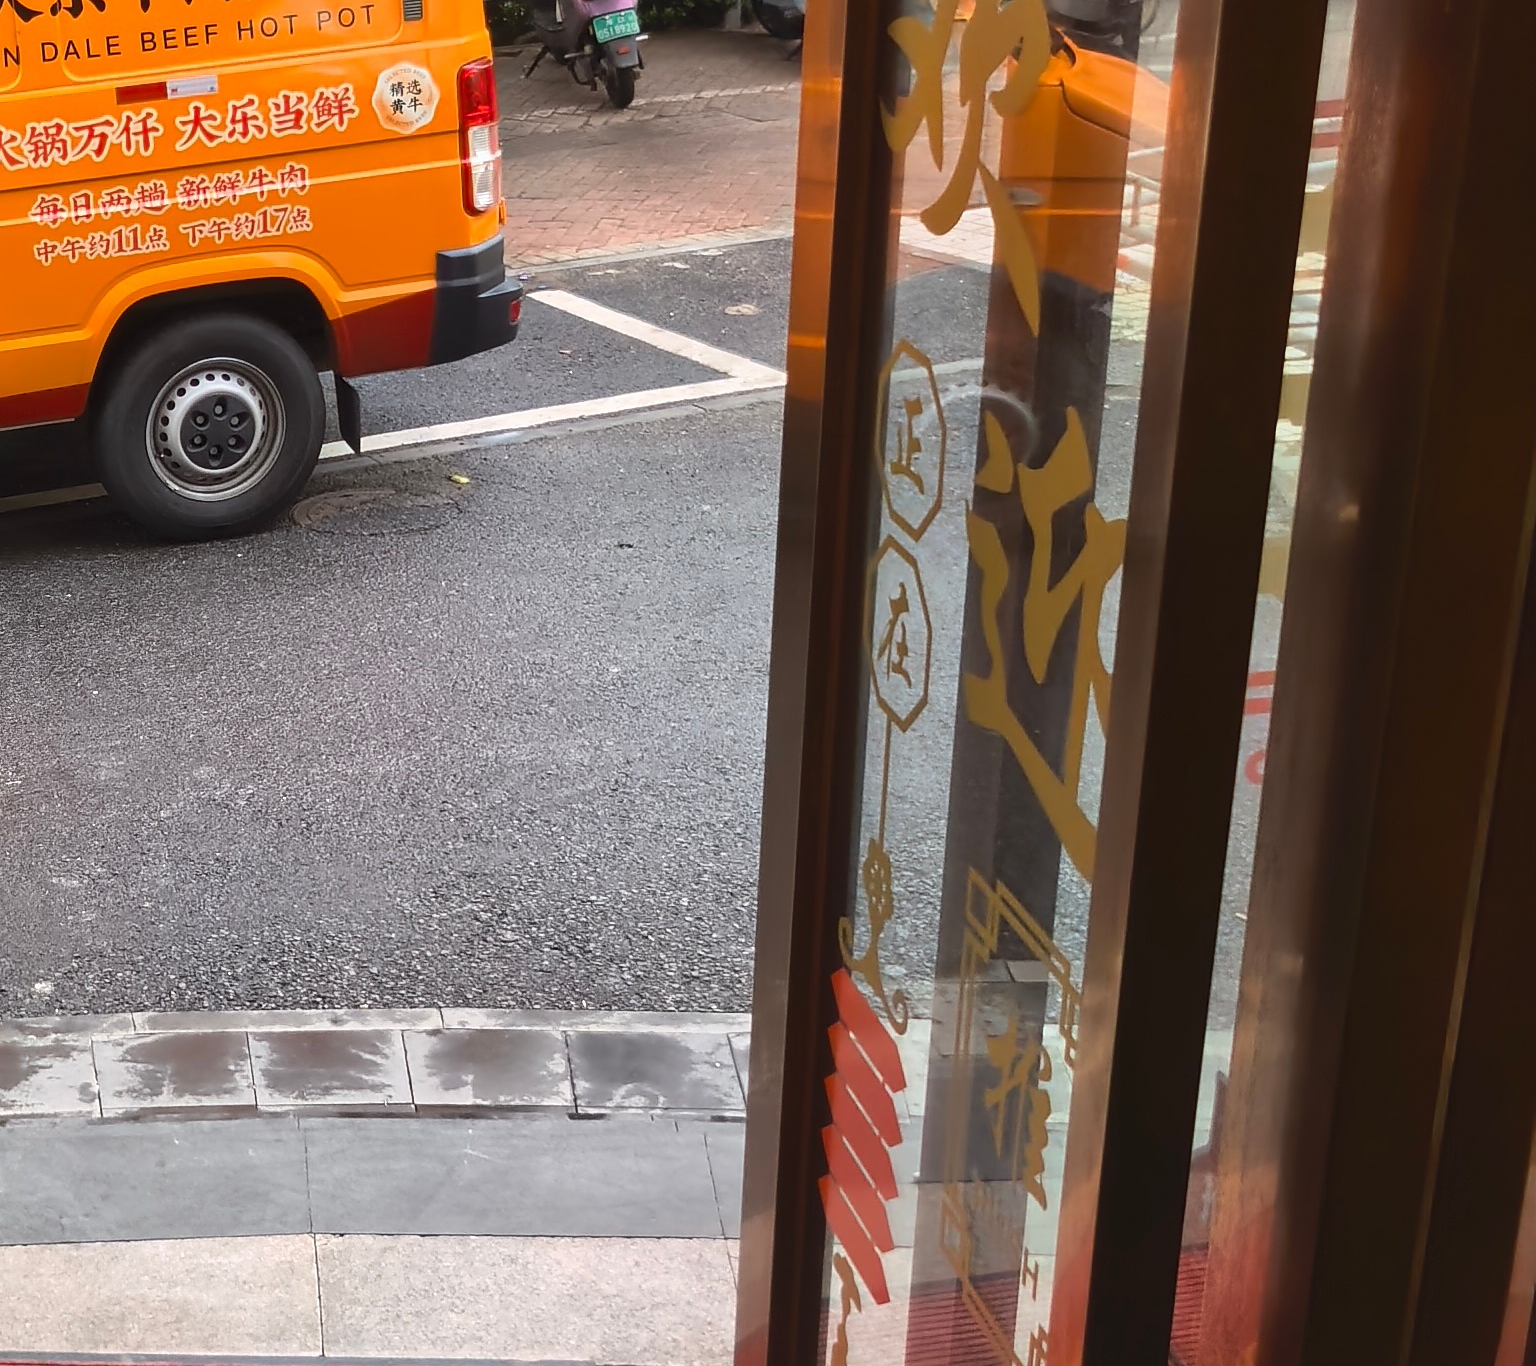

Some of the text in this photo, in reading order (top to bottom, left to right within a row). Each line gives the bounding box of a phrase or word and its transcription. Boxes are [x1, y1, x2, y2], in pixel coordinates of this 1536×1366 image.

[41, 35, 123, 63] DALE
[141, 23, 220, 51] BEEF
[237, 14, 296, 42] HOT
[317, 3, 376, 31] POT
[176, 84, 357, 149] 大乐当鲜
[33, 164, 310, 227] 每日两趟 新鲜牛肉
[35, 205, 312, 266] 中午约11点 下午约17点
